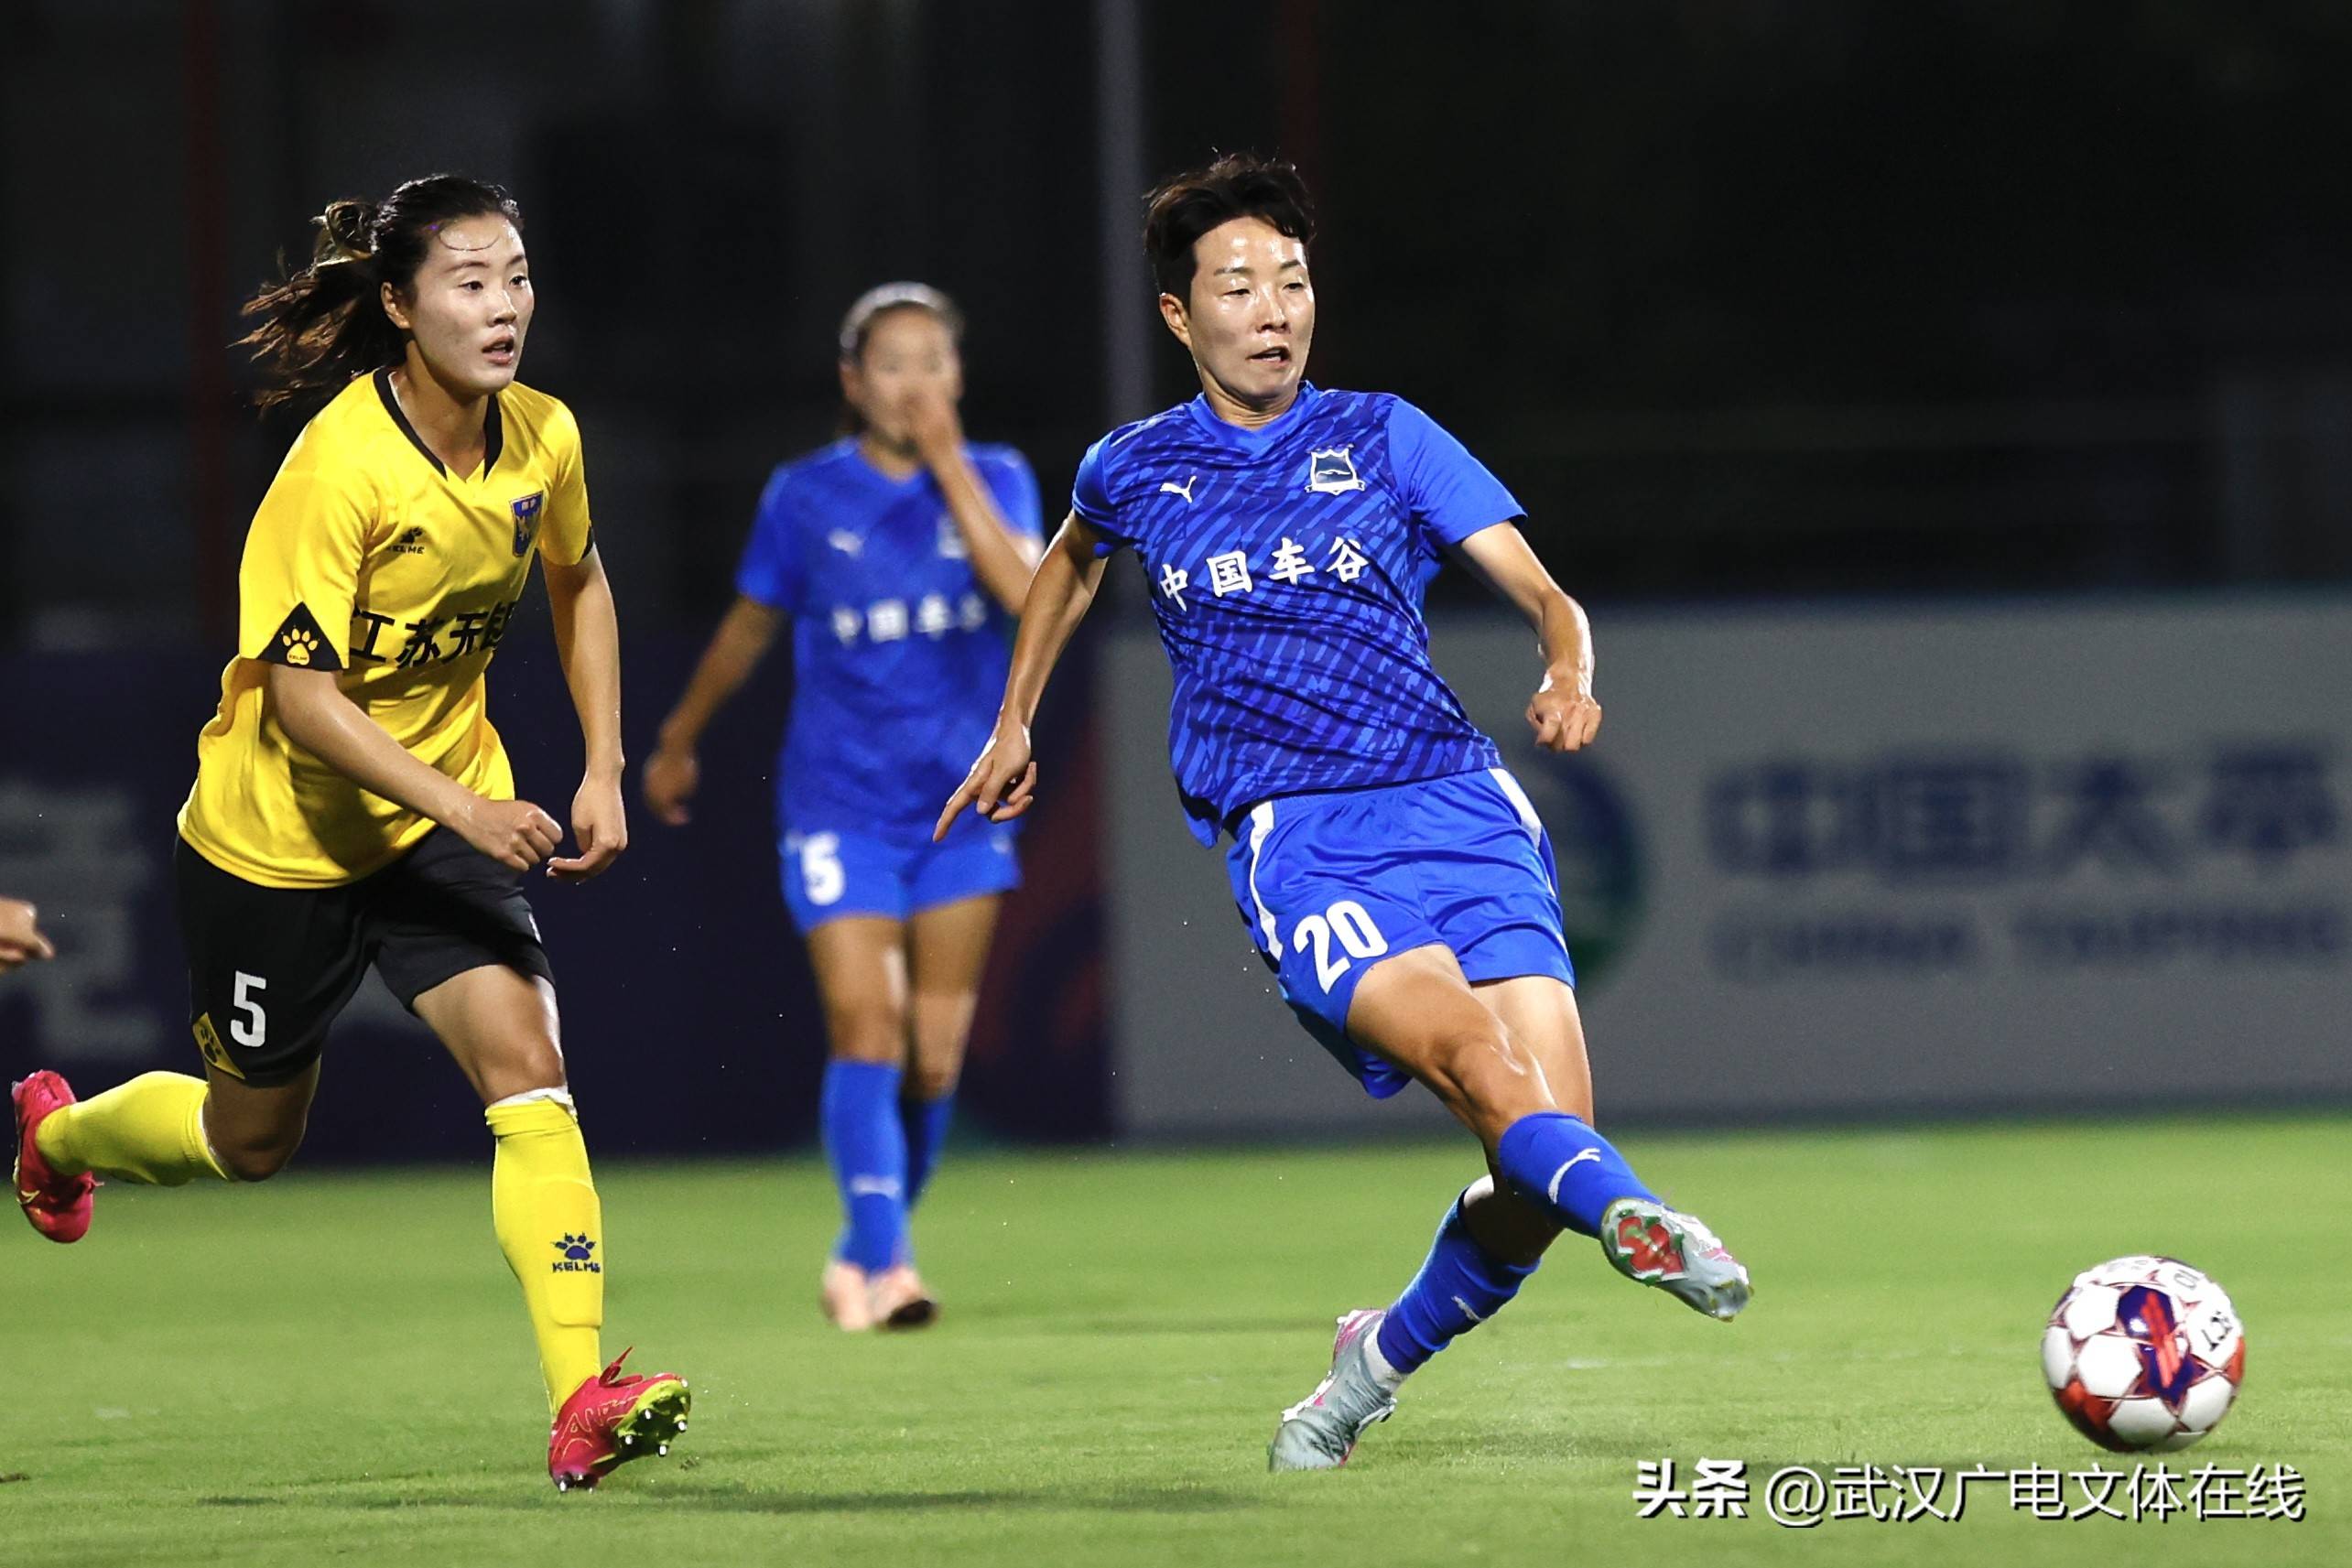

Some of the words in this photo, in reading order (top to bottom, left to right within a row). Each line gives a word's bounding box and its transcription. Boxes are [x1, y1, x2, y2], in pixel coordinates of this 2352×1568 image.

[1159, 535, 1370, 612] 中国车谷
[799, 829, 846, 906] 5
[1293, 900, 1389, 996] 20
[230, 969, 266, 1047] 5
